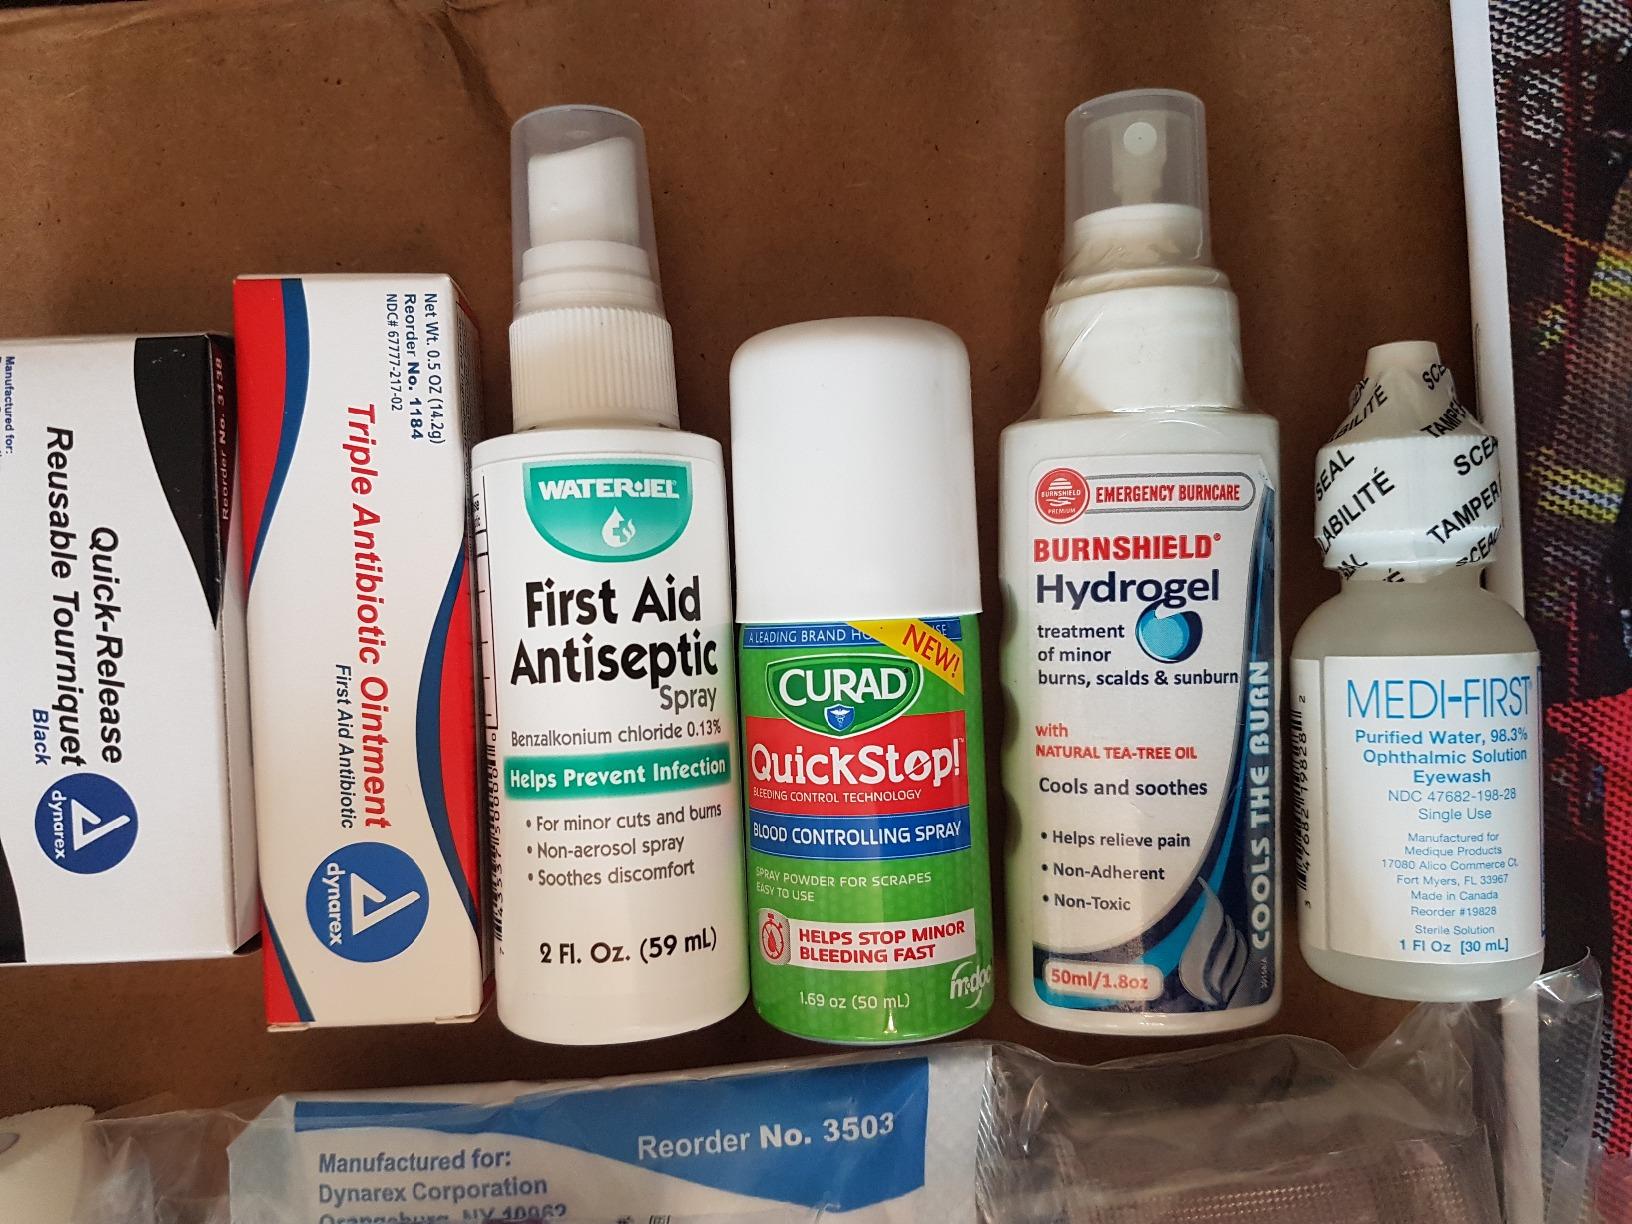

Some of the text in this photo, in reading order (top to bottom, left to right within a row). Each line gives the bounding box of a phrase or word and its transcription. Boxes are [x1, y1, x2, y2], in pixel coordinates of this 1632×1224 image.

[386, 293, 403, 411] NDC# 67777-217-02
[404, 293, 424, 440] Reorder No. 1184
[424, 293, 446, 444] Net Wt. 0.5 OZ (14.2g)
[4, 356, 15, 454] Manufactured for:
[220, 450, 229, 520] Reorder
[1041, 489, 1081, 498] BURNSHIELD
[1095, 484, 1240, 504] EMERGENCY BURNCARE
[46, 426, 87, 767] Reusable Tourniquet
[526, 573, 701, 628] First Aid
[1036, 569, 1220, 610] Hydrogel
[342, 404, 392, 829] Triple Antibiotic Ointment
[755, 630, 797, 644] LEADING
[801, 629, 846, 642] BRAND
[1037, 624, 1125, 639] treatment
[89, 526, 126, 764] Quick-Release
[902, 623, 960, 678] NEW!
[1038, 647, 1112, 662] of minor
[510, 628, 719, 690] Antiseptic
[779, 667, 907, 707] CURAD
[1038, 669, 1240, 688] burns, scalds & sunburn
[660, 684, 717, 716] Spray
[1249, 660, 1270, 755] BURN
[32, 708, 51, 766] Black
[511, 718, 721, 747] Benzalkonium chloride 0.13%
[1036, 722, 1069, 737] with
[1355, 727, 1528, 746] Purified Water, 98.3%
[336, 664, 357, 829] First Aid Antibiotic
[1036, 744, 1197, 759] NATURAL TEA-TREE OIL
[1363, 748, 1527, 766] Ophthalmic Solution
[510, 757, 726, 792] Helps Prevent Infection
[1039, 777, 1208, 795] Cools and soothes
[1413, 769, 1491, 786] Eyewash
[753, 786, 922, 803] BLEEDING CONTROL TECHNOLOGY
[1250, 765, 1271, 829] THE
[1388, 787, 1517, 803] NDC 47682-198-28
[48, 790, 67, 860] dynarex
[536, 803, 722, 831] For minor cuts and burns
[1418, 808, 1492, 823] Single Use
[753, 820, 962, 846] BLOOD CONTROLLING SPRAY
[1052, 830, 1191, 850] Helps relieve pain
[1408, 832, 1500, 843] Manufactured for
[537, 836, 685, 858] Non-aerosol spray
[1404, 846, 1502, 859] Medique Products
[538, 859, 695, 886] Soothes discomfort
[755, 866, 932, 887] SPRAY POWDER FOR SCRAPES
[1053, 862, 1165, 880] Non-Adherent
[1381, 859, 1415, 870] 17080
[1419, 860, 1447, 870] Alico
[1450, 860, 1506, 871] Commerce
[756, 882, 815, 902] EASY TO USE
[1396, 874, 1508, 887] Fort Myers, FL 33967
[322, 862, 346, 946] dynarex
[1054, 893, 1131, 911] Non-Toxic
[1251, 836, 1272, 950] COOLS
[1411, 890, 1499, 901] Made in Canada
[1411, 906, 1497, 917] Reorder #19828
[799, 920, 965, 946] HELPS STOP MINOR
[1415, 925, 1495, 935] Sterile Solution
[540, 926, 717, 964] 2 Fl. Oz. (59 mL)
[799, 944, 936, 964] BLEEDING FAST
[1399, 938, 1509, 955] 1 Fl Oz [30 mL]
[1051, 968, 1149, 991] 50ml/1.8oz
[799, 991, 910, 1010] 1.69 oz (50 mL)
[637, 1112, 894, 1160] Reorder No. 3503
[319, 1148, 512, 1173] Manufactured for:
[319, 1177, 548, 1208] Dynarex Corporation
